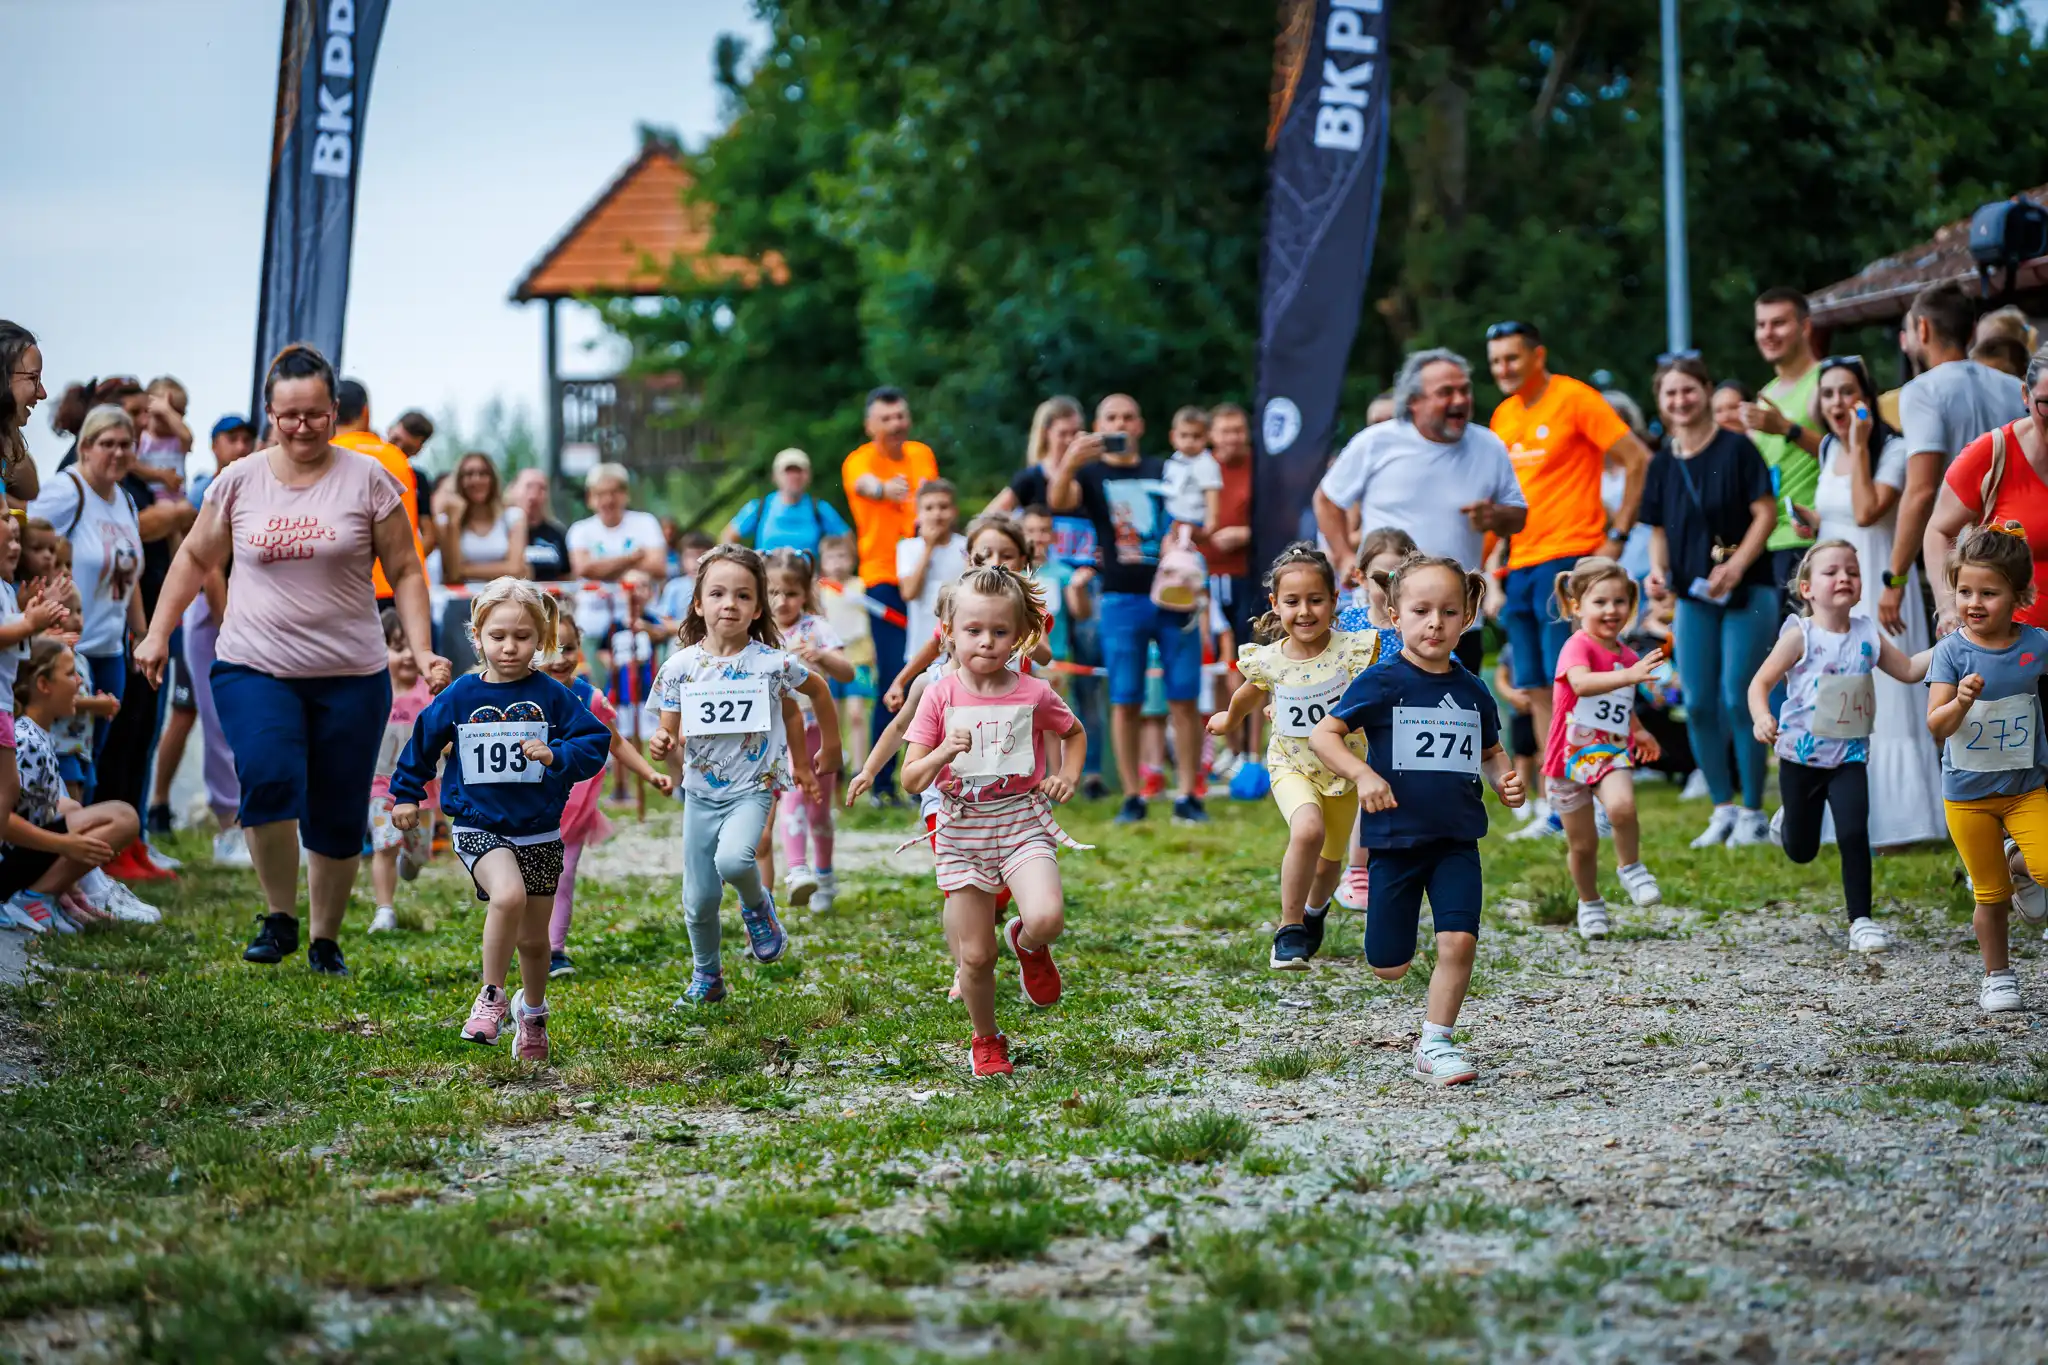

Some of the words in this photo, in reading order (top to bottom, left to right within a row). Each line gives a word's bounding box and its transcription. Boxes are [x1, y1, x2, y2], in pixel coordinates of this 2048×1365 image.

[1314, 57, 1375, 152] BK
[311, 83, 354, 179] BK
[264, 515, 319, 532] Girls
[700, 700, 753, 723] 327
[1289, 695, 1340, 727] 20
[1595, 700, 1632, 724] 35
[976, 721, 1016, 757] 173
[1416, 732, 1473, 760] 274
[1966, 715, 2028, 752] 275
[473, 742, 528, 774] 193
